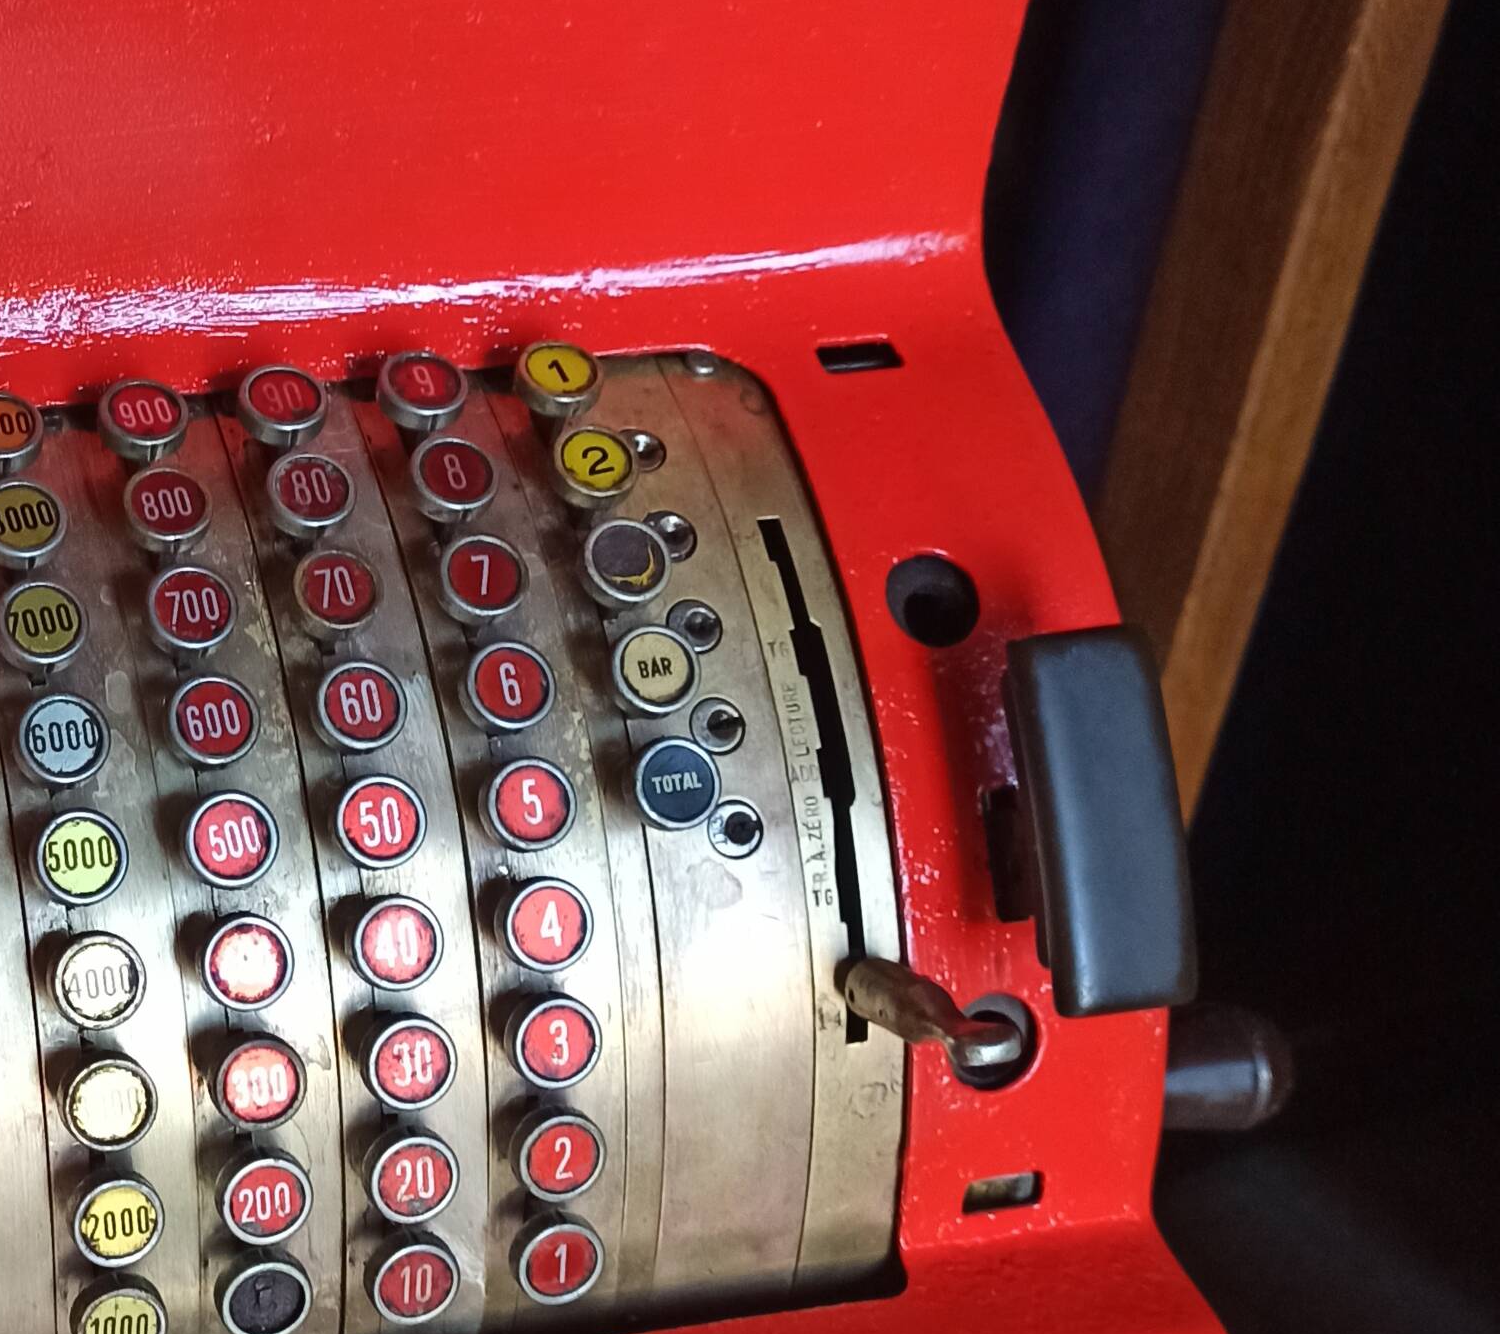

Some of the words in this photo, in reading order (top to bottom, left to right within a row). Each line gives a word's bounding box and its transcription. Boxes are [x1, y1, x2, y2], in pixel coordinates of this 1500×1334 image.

[413, 365, 436, 396] 9
[547, 358, 570, 383] 1
[118, 397, 174, 429] 900
[263, 380, 301, 413] 90
[443, 453, 467, 490] 8
[581, 446, 616, 475] 2
[141, 486, 193, 522] 800
[293, 469, 332, 505] 80
[313, 566, 355, 609] 70
[471, 554, 491, 596] 7
[10, 602, 74, 637] 7000
[165, 587, 221, 626] 700
[499, 661, 522, 707] 6
[637, 655, 673, 679] BAR
[186, 698, 242, 741] 600
[339, 678, 382, 725] 60
[31, 715, 98, 755] 6000
[522, 778, 545, 825] 5
[651, 771, 703, 794] TOTAL
[208, 815, 261, 863] 500
[359, 795, 402, 846] 50
[47, 835, 114, 873] 5000
[374, 916, 419, 968] 40
[540, 899, 563, 948] 4
[66, 963, 132, 1000] 4000
[392, 1037, 434, 1087] 30
[549, 1018, 570, 1066] 3
[230, 1060, 289, 1108] 300
[396, 1155, 436, 1201] 20
[555, 1134, 574, 1180] 2
[238, 1180, 292, 1225] 200
[89, 1204, 152, 1244] 2000
[401, 1262, 433, 1305] 10
[555, 1242, 568, 1284] 1
